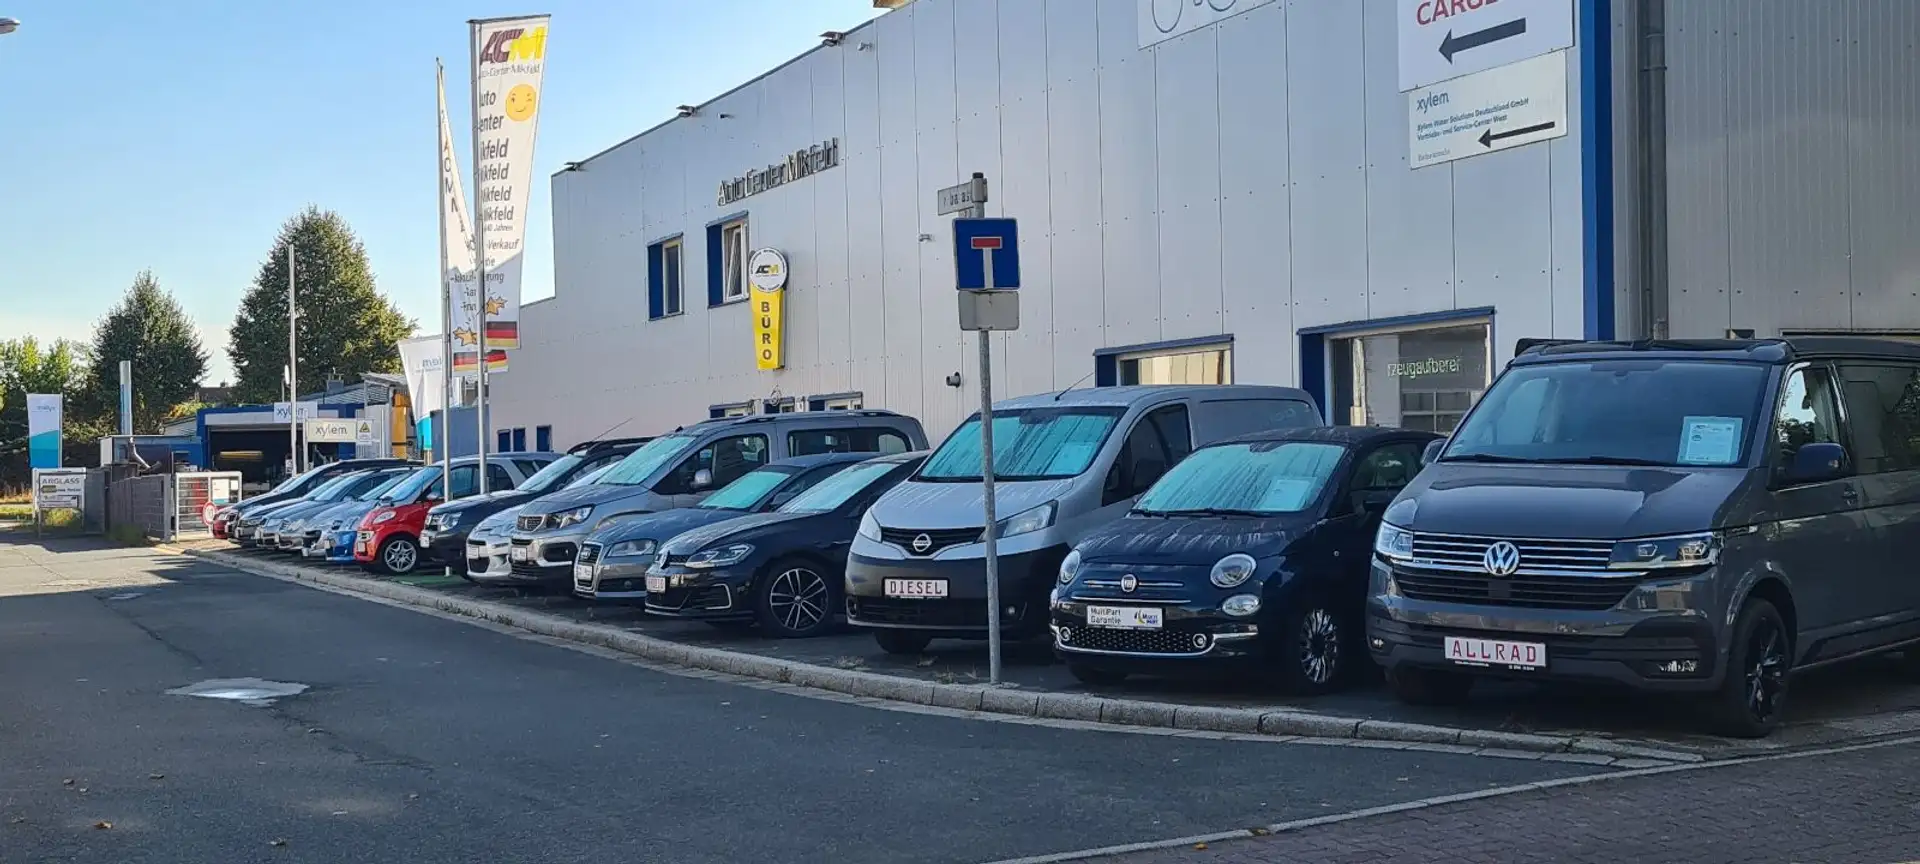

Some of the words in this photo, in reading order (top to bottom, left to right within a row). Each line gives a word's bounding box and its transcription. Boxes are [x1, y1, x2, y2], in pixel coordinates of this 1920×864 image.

[480, 91, 496, 107] uto
[1417, 92, 1449, 114] xylem
[480, 114, 504, 133] enter
[718, 176, 746, 206] Auto
[276, 405, 304, 419] xylm
[315, 423, 348, 437] xylem
[890, 581, 942, 595] DIESEL
[1453, 640, 1537, 663] ALLRAD
